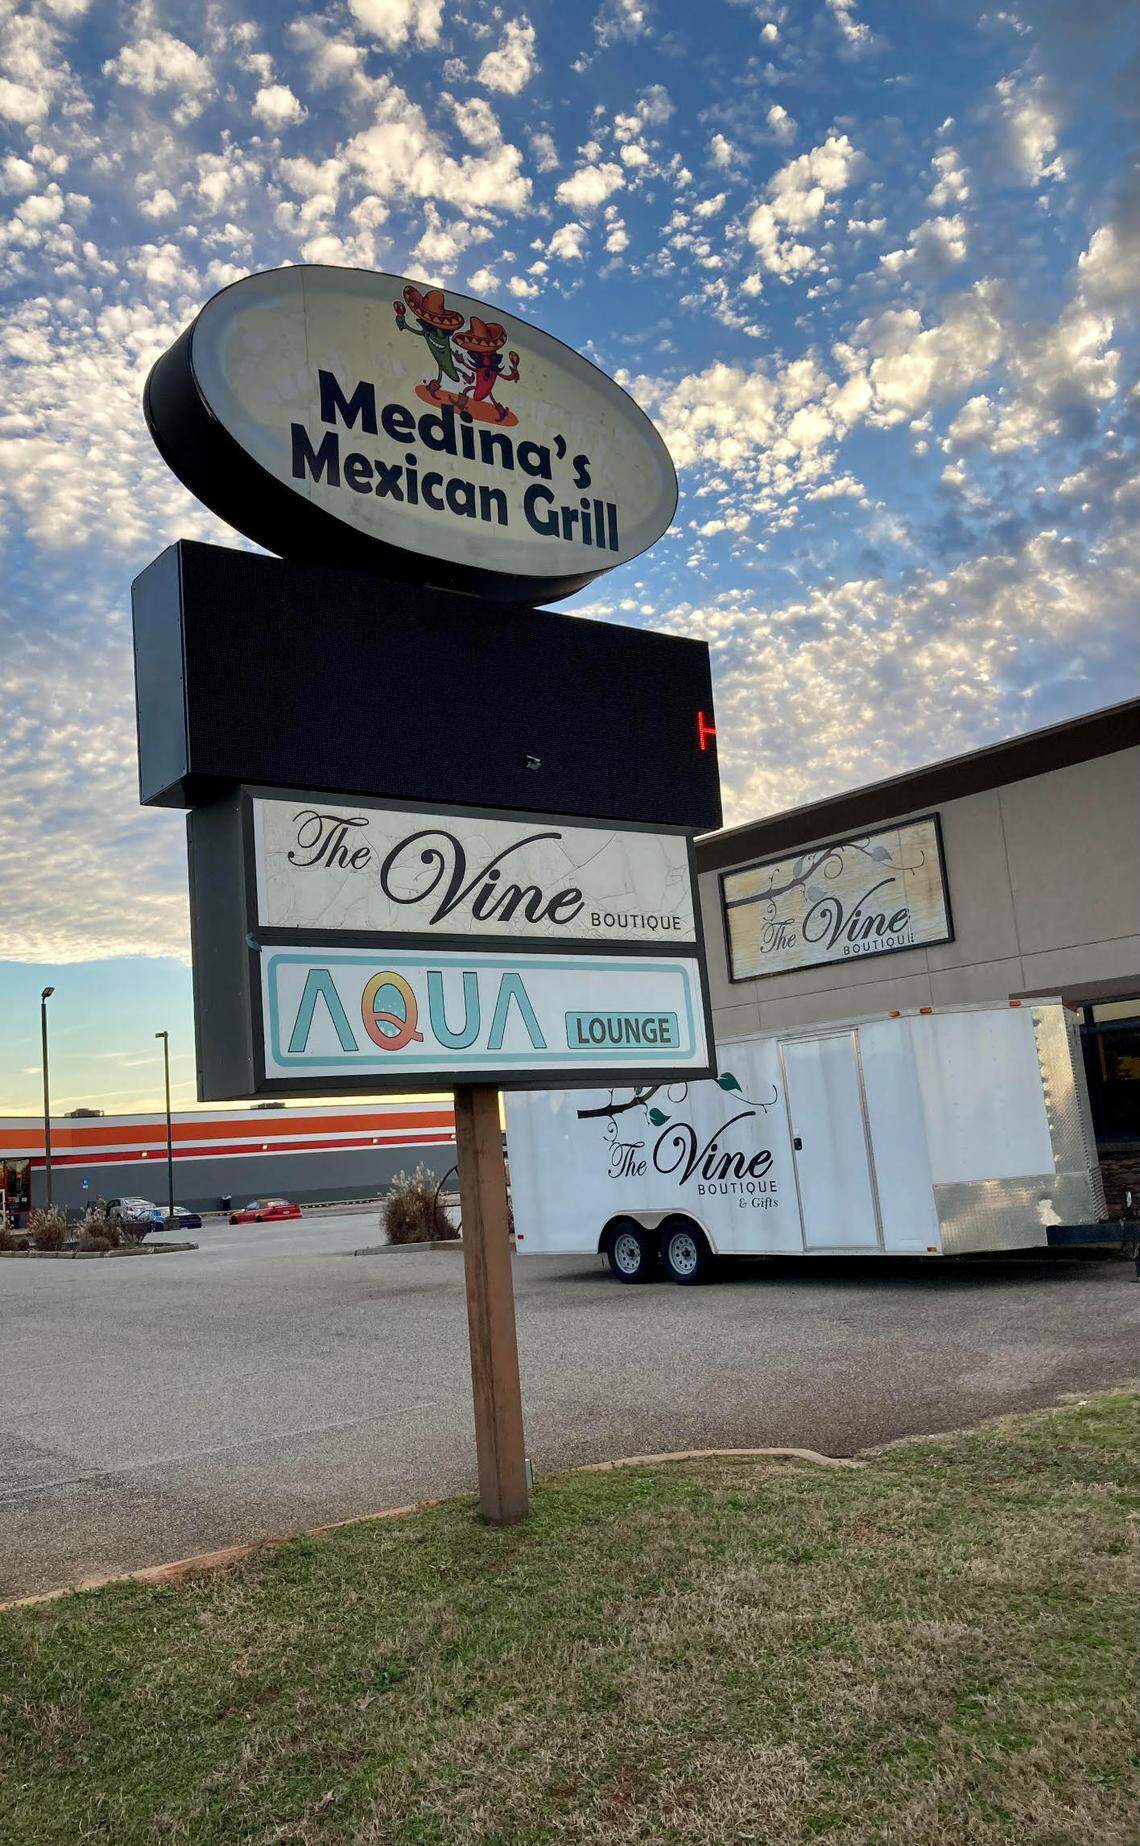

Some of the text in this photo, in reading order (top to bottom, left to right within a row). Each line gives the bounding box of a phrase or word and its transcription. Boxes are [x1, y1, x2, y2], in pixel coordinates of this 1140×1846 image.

[318, 369, 592, 489] Medina's
[290, 422, 619, 551] Mexican Grill
[287, 810, 682, 931] The Vine BOUTIQUE
[760, 877, 910, 953] The Vine
[288, 969, 672, 1052] AQUA LOUNGE
[608, 1111, 774, 1186] The Vine
[698, 1181, 777, 1195] BOUTIQUE
[739, 1197, 779, 1210] & Gifts
